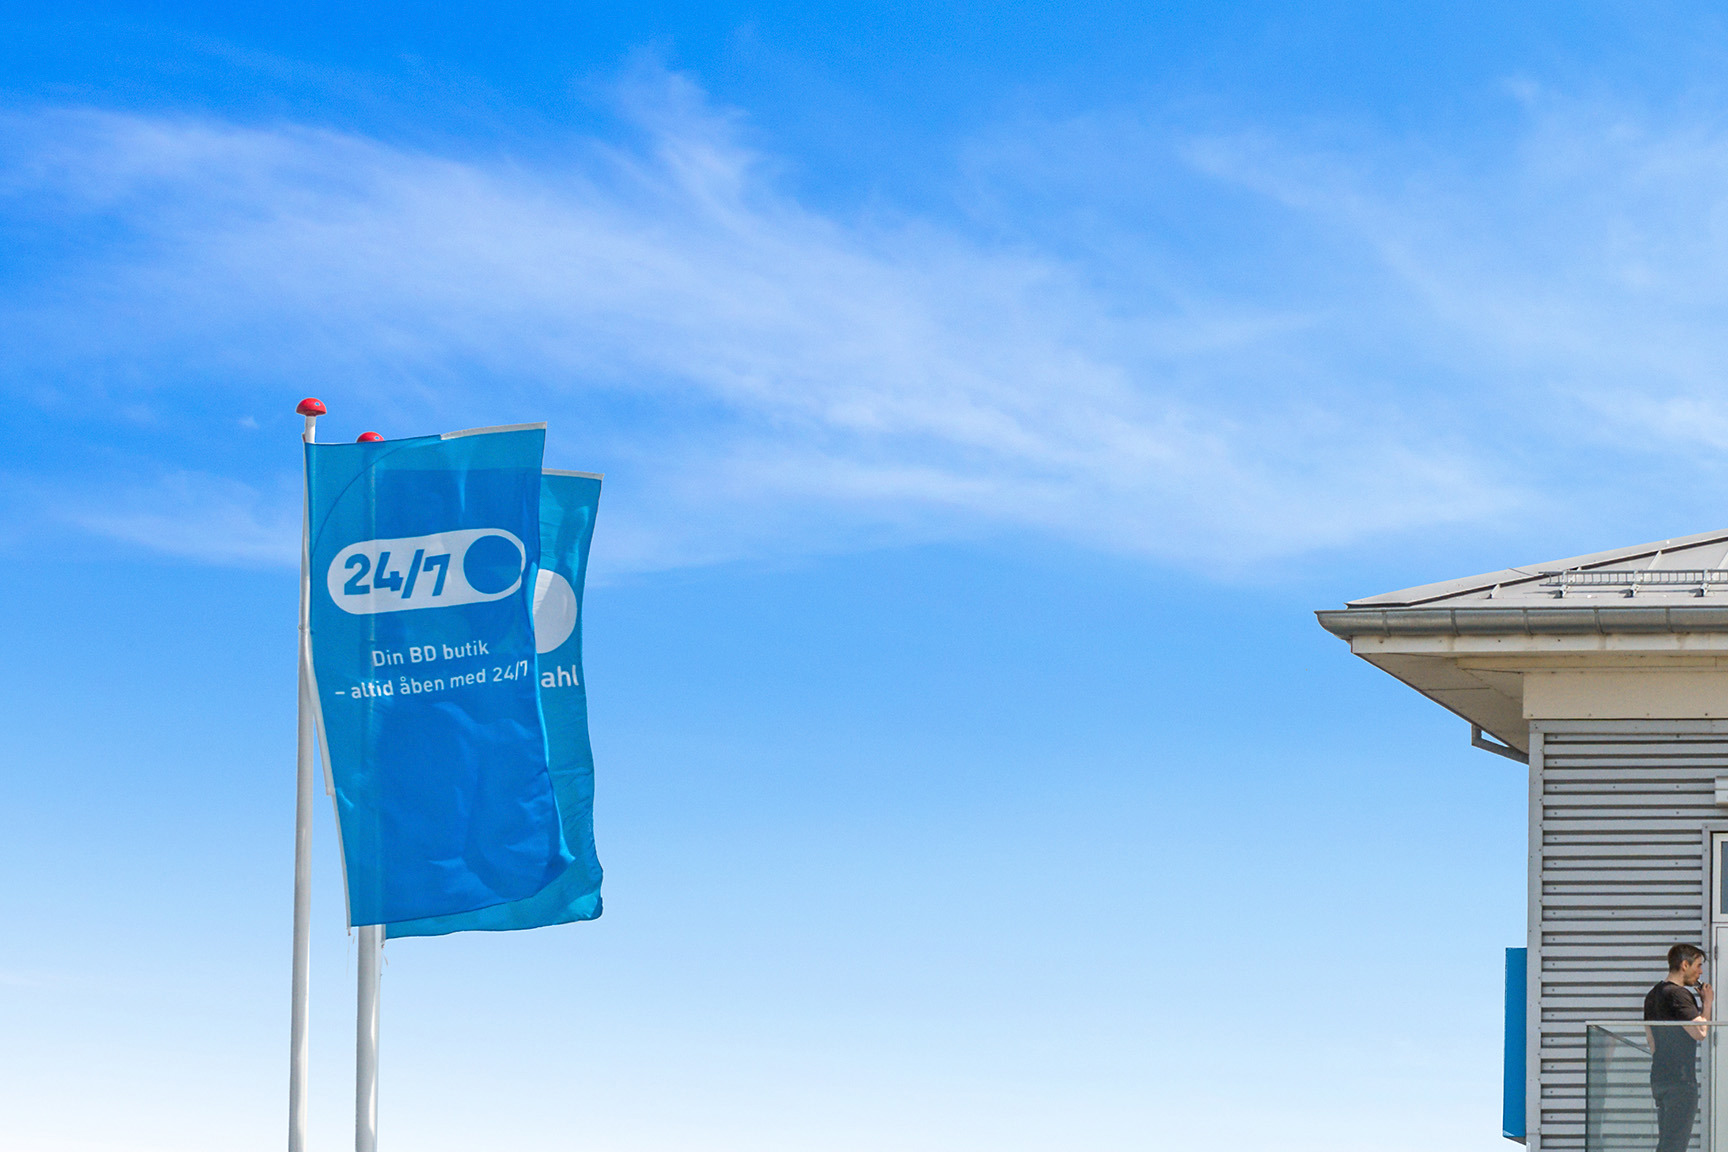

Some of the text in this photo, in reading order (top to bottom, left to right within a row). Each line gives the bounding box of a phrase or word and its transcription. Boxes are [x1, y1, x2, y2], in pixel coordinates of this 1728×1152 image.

[343, 549, 451, 599] 24/7
[372, 640, 489, 667] Din BD butik
[351, 680, 394, 699] altid
[399, 676, 445, 695] åben
[450, 669, 486, 689] med
[492, 660, 528, 682] 24/7
[541, 664, 579, 688] ahl
